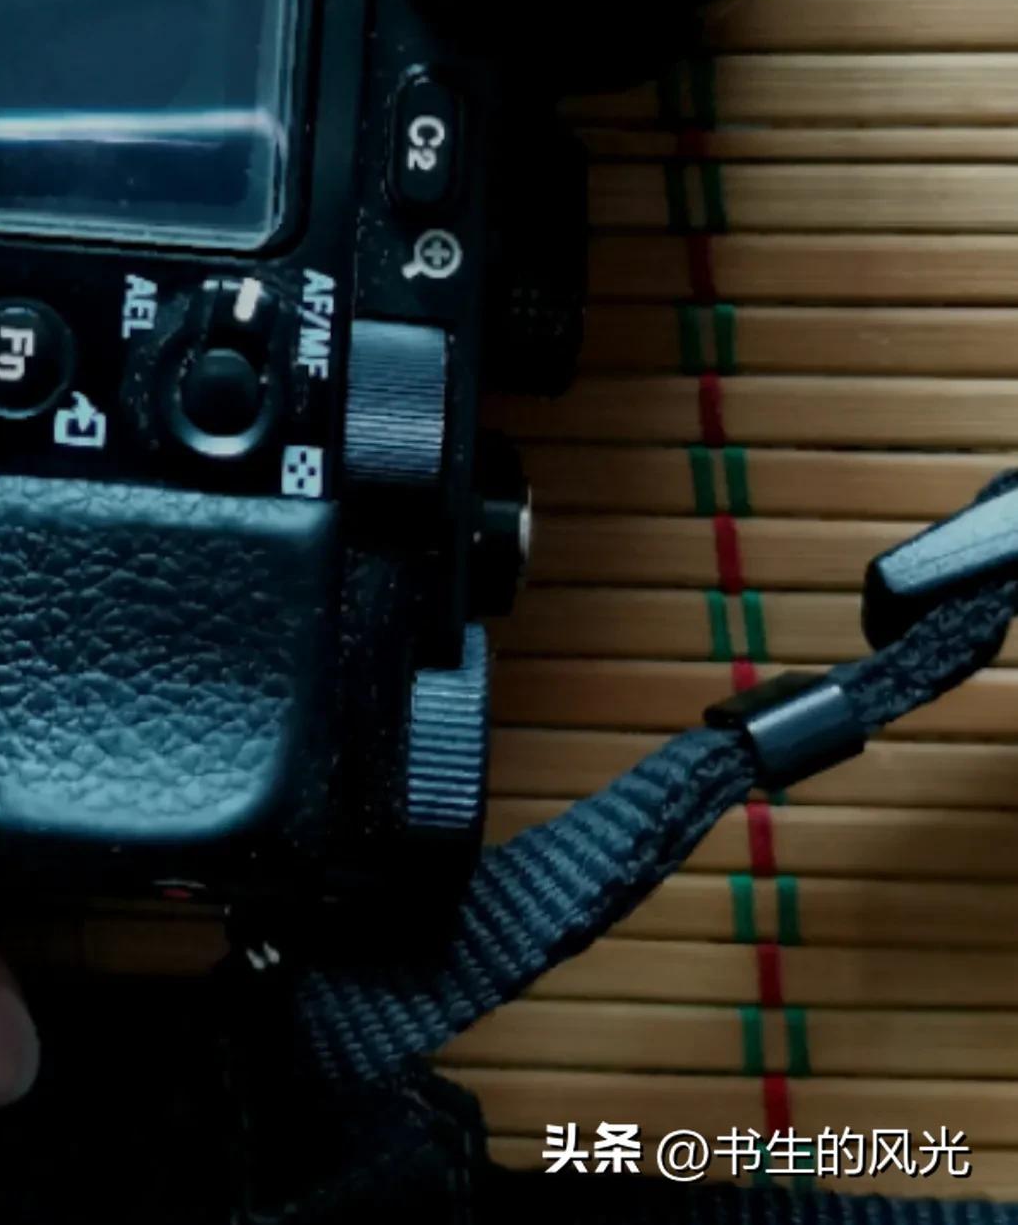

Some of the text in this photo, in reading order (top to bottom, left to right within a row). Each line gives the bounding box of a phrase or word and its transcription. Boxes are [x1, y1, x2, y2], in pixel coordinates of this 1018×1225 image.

[407, 115, 445, 170] C2
[122, 274, 158, 339] AEL
[296, 269, 336, 379] AF/MF
